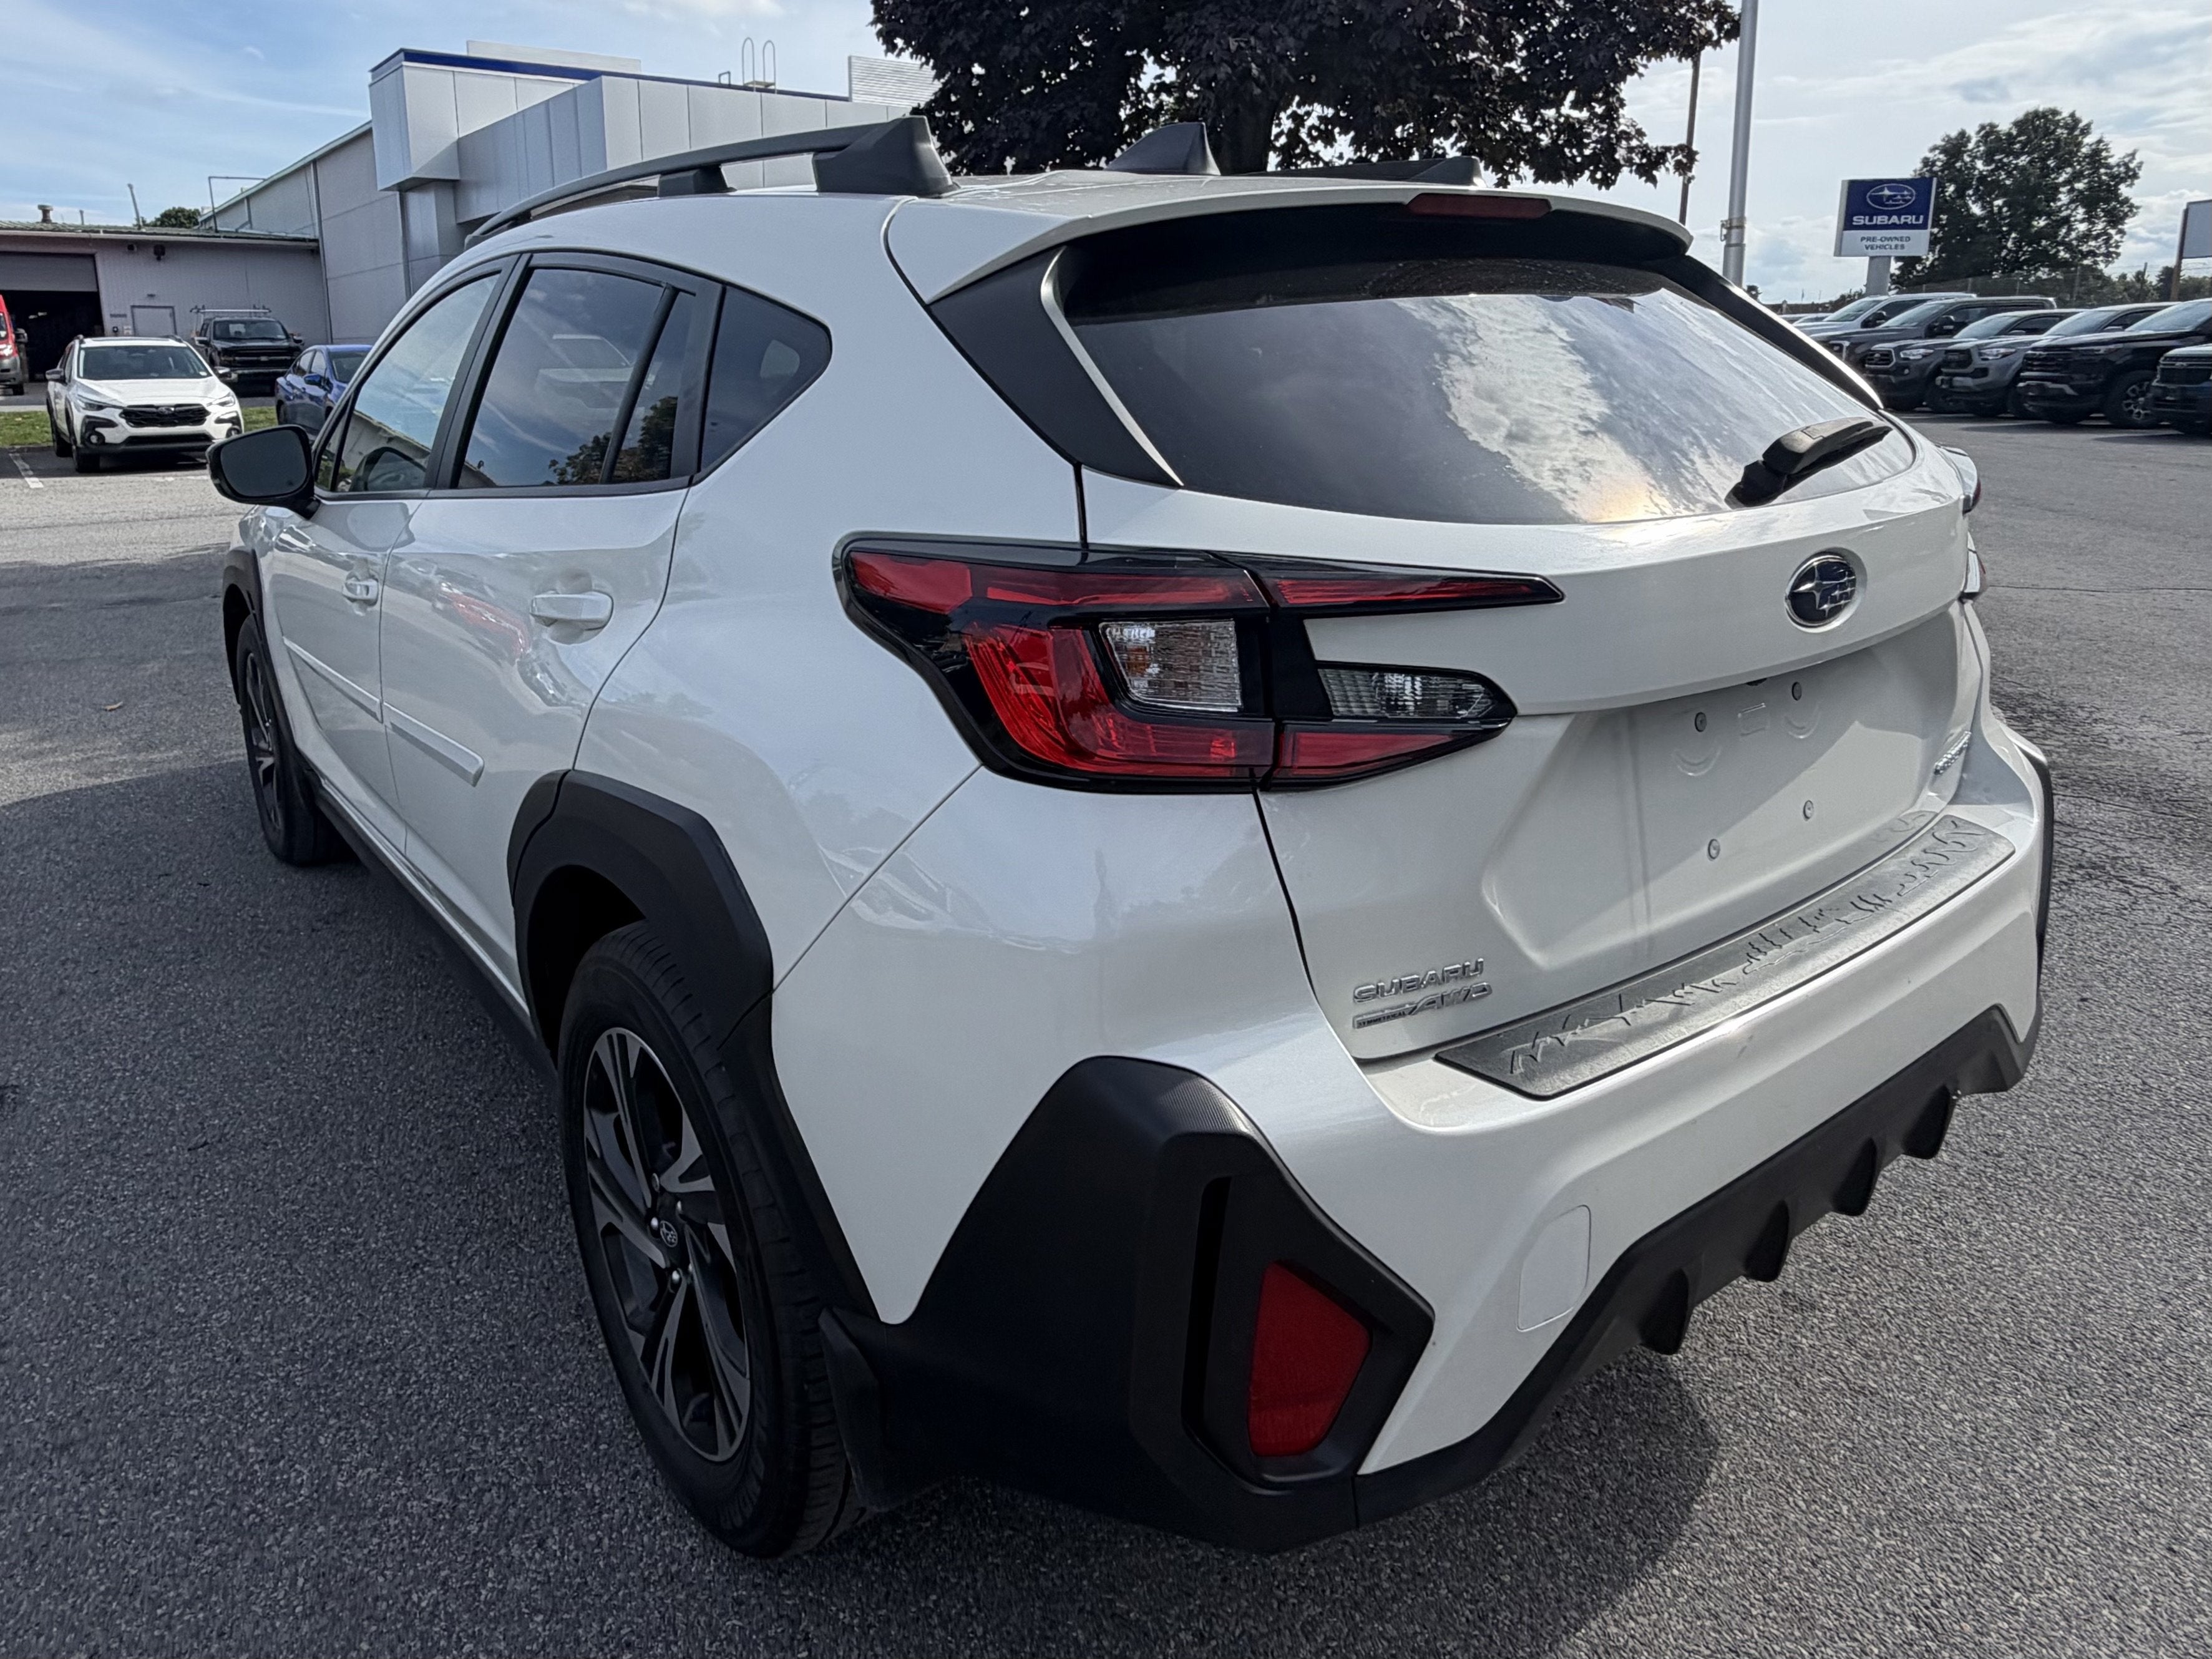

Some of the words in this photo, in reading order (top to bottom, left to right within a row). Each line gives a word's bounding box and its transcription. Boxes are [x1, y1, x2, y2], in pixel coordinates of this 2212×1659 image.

[1852, 215, 1924, 225] SUBARU
[1353, 958, 1484, 1004] SUBARU
[1408, 981, 1493, 1016] AWD
